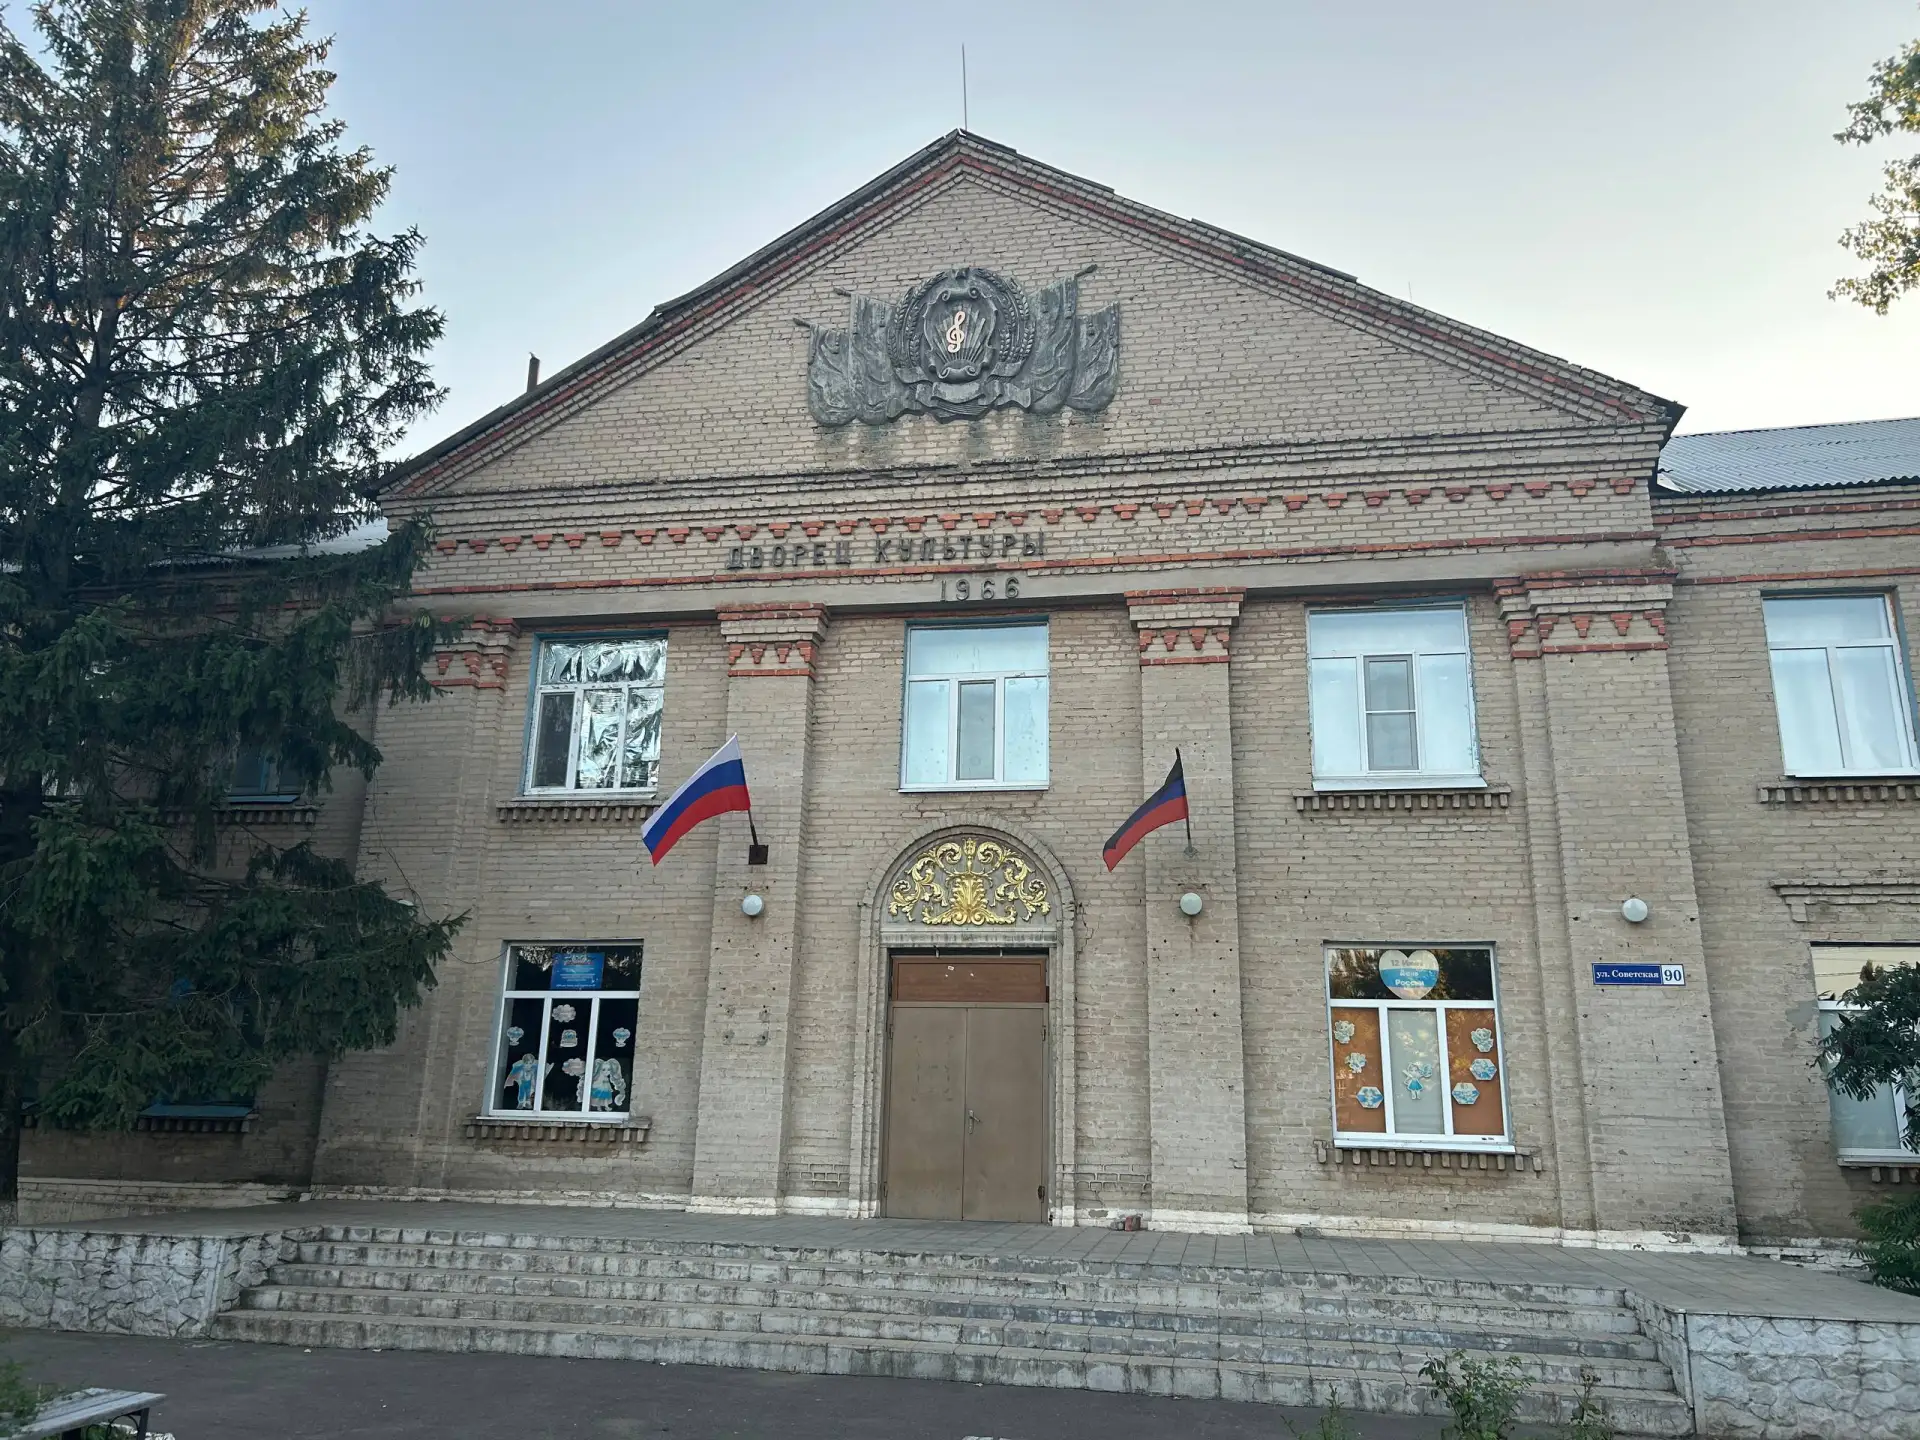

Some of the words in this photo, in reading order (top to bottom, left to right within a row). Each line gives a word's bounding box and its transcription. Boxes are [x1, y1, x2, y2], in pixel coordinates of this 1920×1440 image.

[726, 540, 851, 569] ДВОРЕЦ
[874, 531, 1045, 563] КУЛЬТУРЫ
[941, 576, 1020, 601] 1966
[1596, 970, 1610, 979] ул.
[1611, 969, 1659, 979] Советская
[1664, 969, 1682, 981] 90
